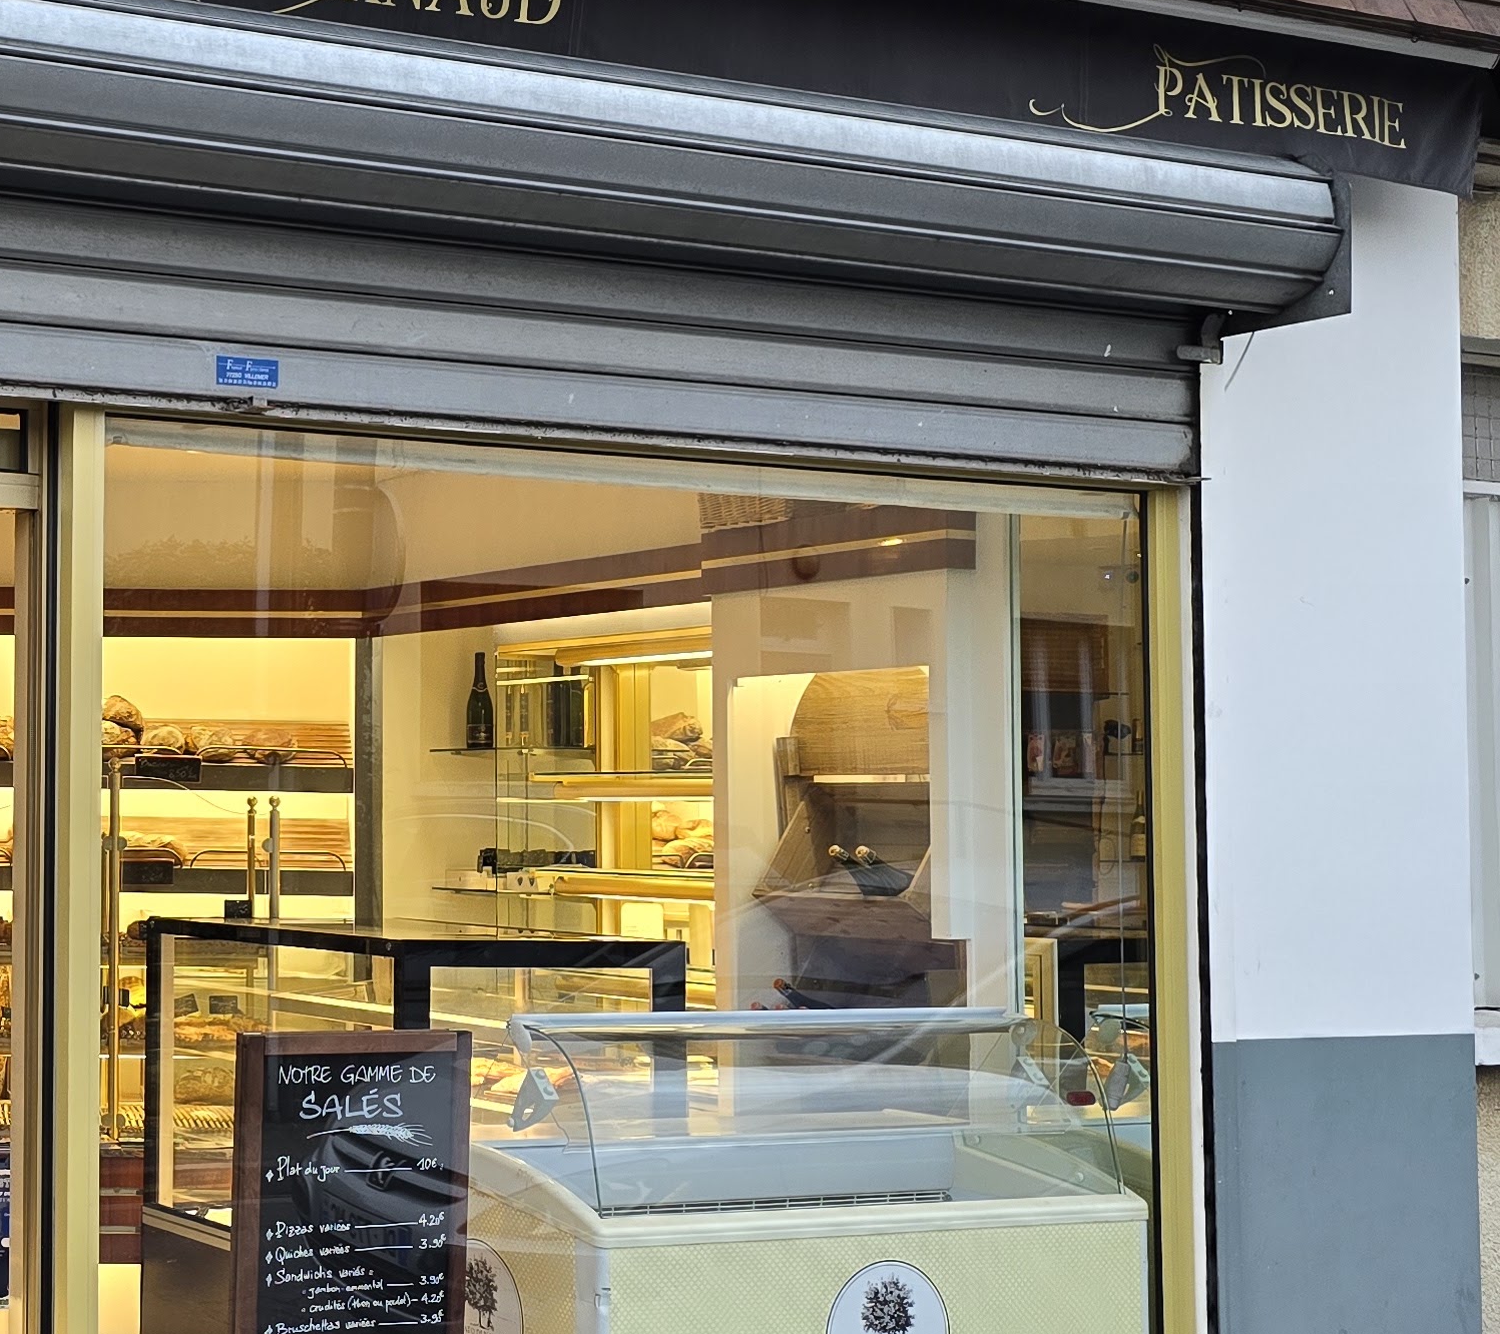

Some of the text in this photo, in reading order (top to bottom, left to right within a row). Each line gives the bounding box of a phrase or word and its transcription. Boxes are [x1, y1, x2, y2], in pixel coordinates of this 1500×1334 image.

[1154, 60, 1407, 149] PATISSERIE
[278, 1064, 436, 1085] NOTRE GAMME DE
[299, 1088, 404, 1120] SALÉS
[276, 1155, 302, 1182] Plat
[304, 1162, 318, 1174] du
[317, 1165, 341, 1182] jour
[275, 1220, 314, 1239] Pizzas
[275, 1245, 314, 1265] Quiches
[274, 1266, 333, 1285] Sandwichs
[373, 1299, 384, 1308] ou
